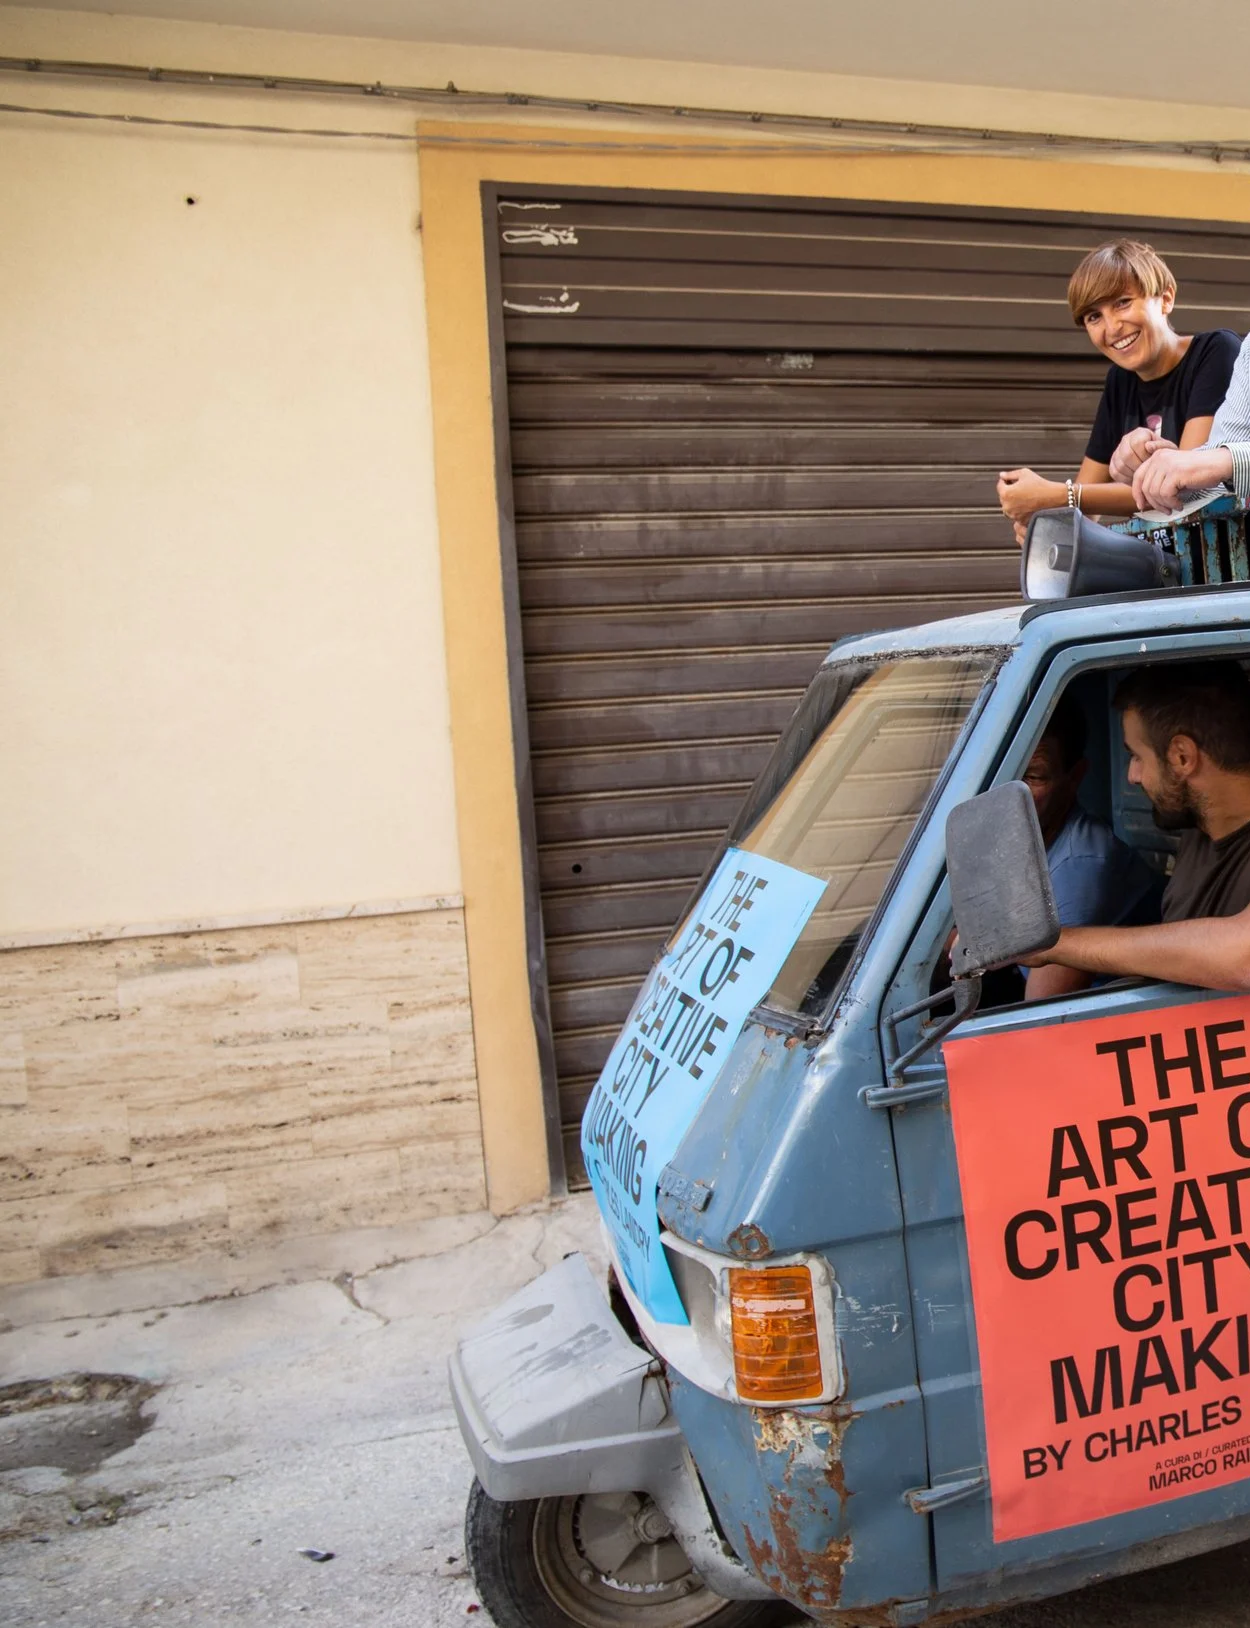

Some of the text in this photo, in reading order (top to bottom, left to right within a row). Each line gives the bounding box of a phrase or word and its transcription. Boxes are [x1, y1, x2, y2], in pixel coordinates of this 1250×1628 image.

[710, 870, 768, 932] THE
[700, 938, 755, 1000] OF
[613, 1036, 670, 1119] CITY
[1047, 1103, 1198, 1198] ART
[1023, 1440, 1072, 1479] BY
[1084, 1396, 1242, 1463] CHARLES
[1156, 1462, 1161, 1470] A
[1165, 1455, 1190, 1468] CURA
[1193, 1451, 1202, 1460] DI
[1149, 1459, 1217, 1491] MARCO
